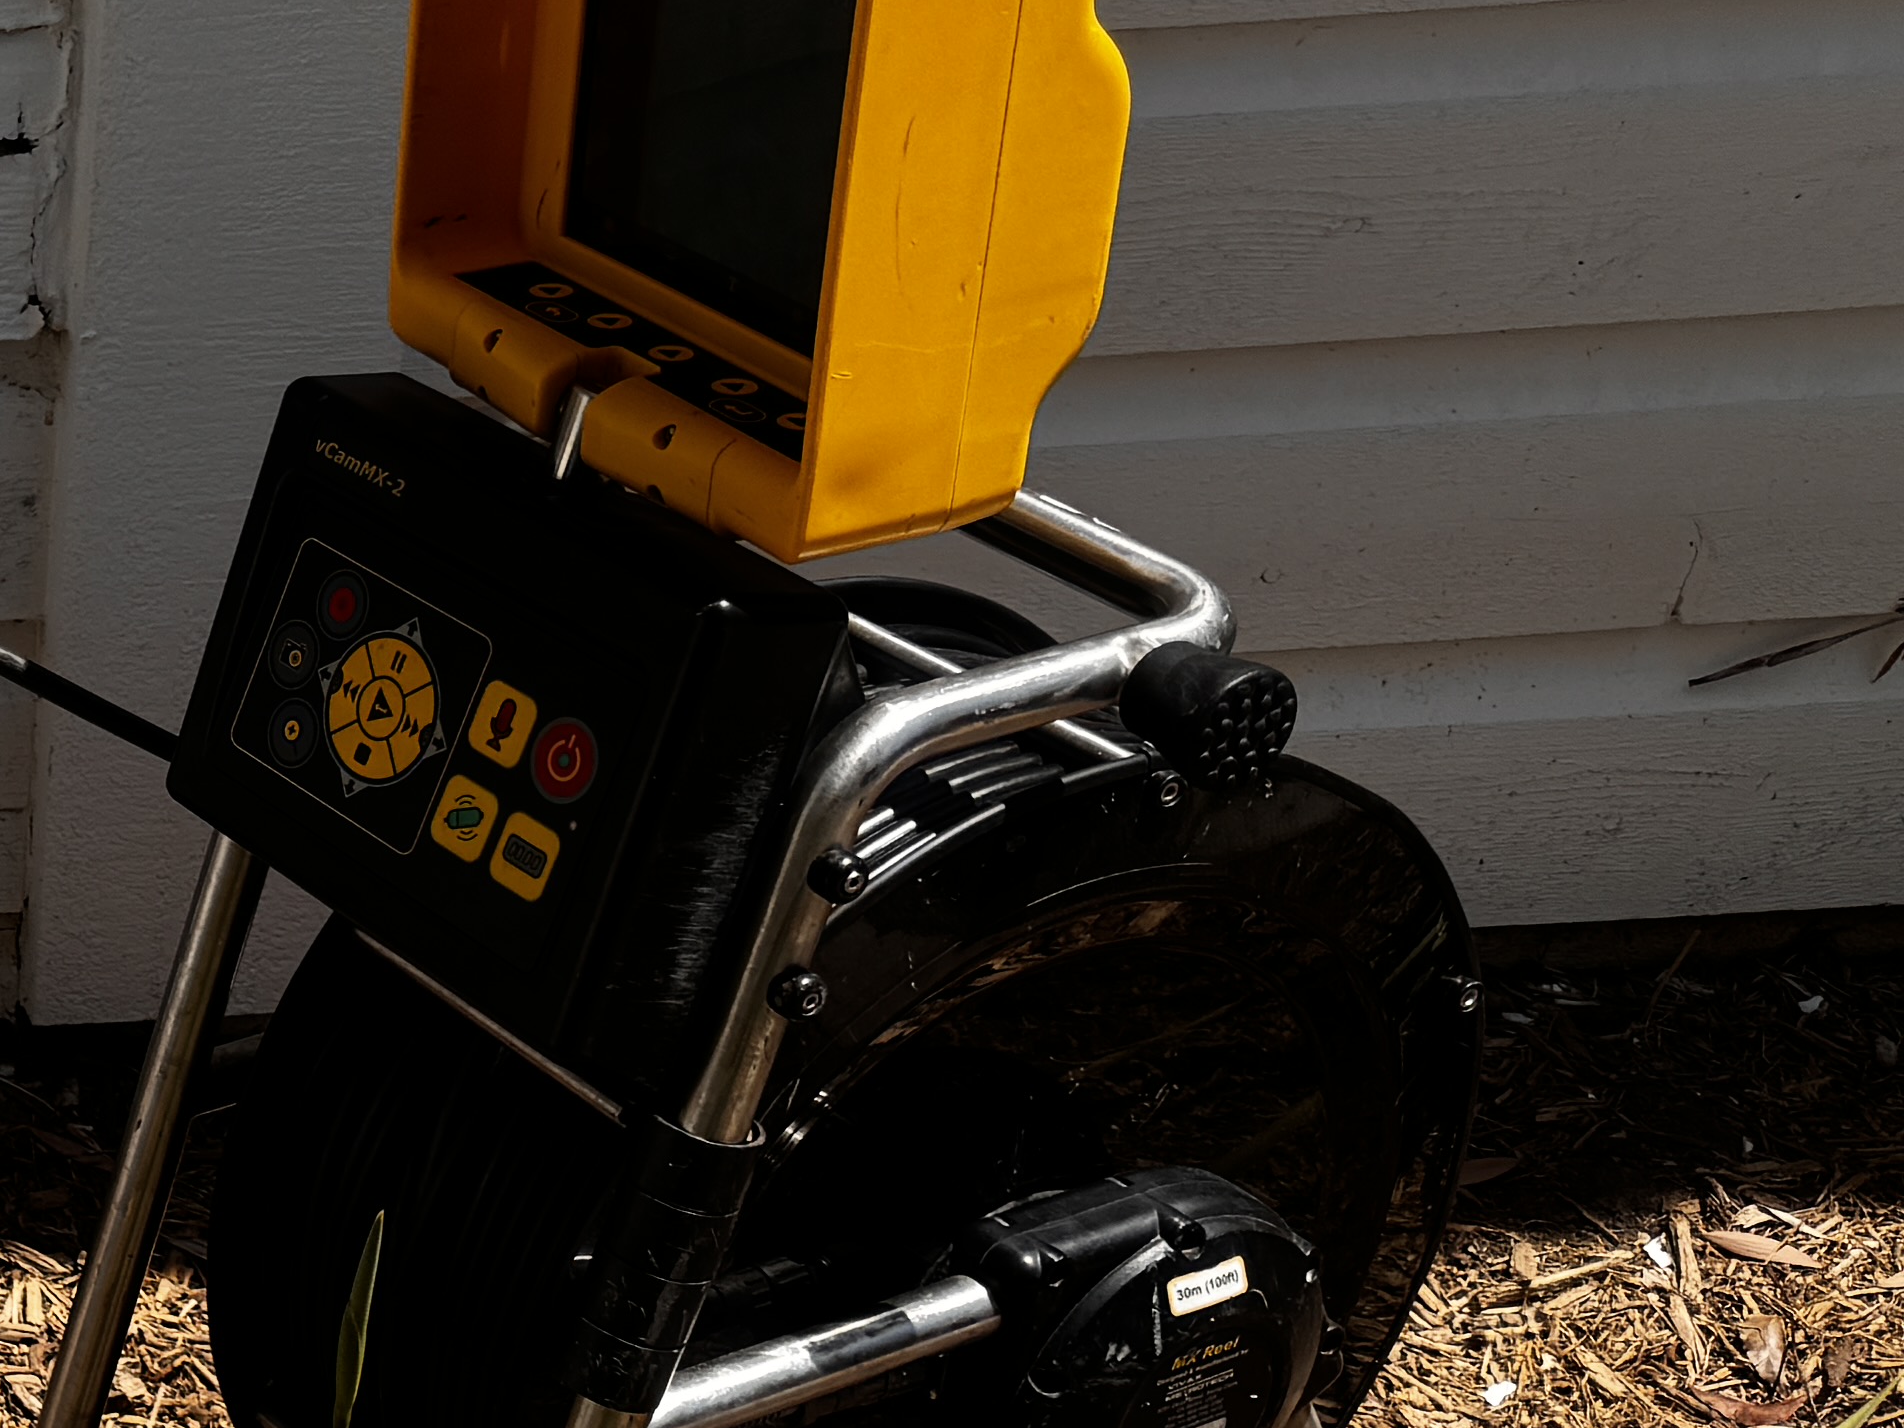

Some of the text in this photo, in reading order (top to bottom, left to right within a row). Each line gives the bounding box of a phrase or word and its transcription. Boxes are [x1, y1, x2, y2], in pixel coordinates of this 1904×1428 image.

[315, 438, 406, 498] vCamMX-2
[1176, 1269, 1239, 1302] 30m (100ft)
[1202, 1335, 1241, 1360] Reel
